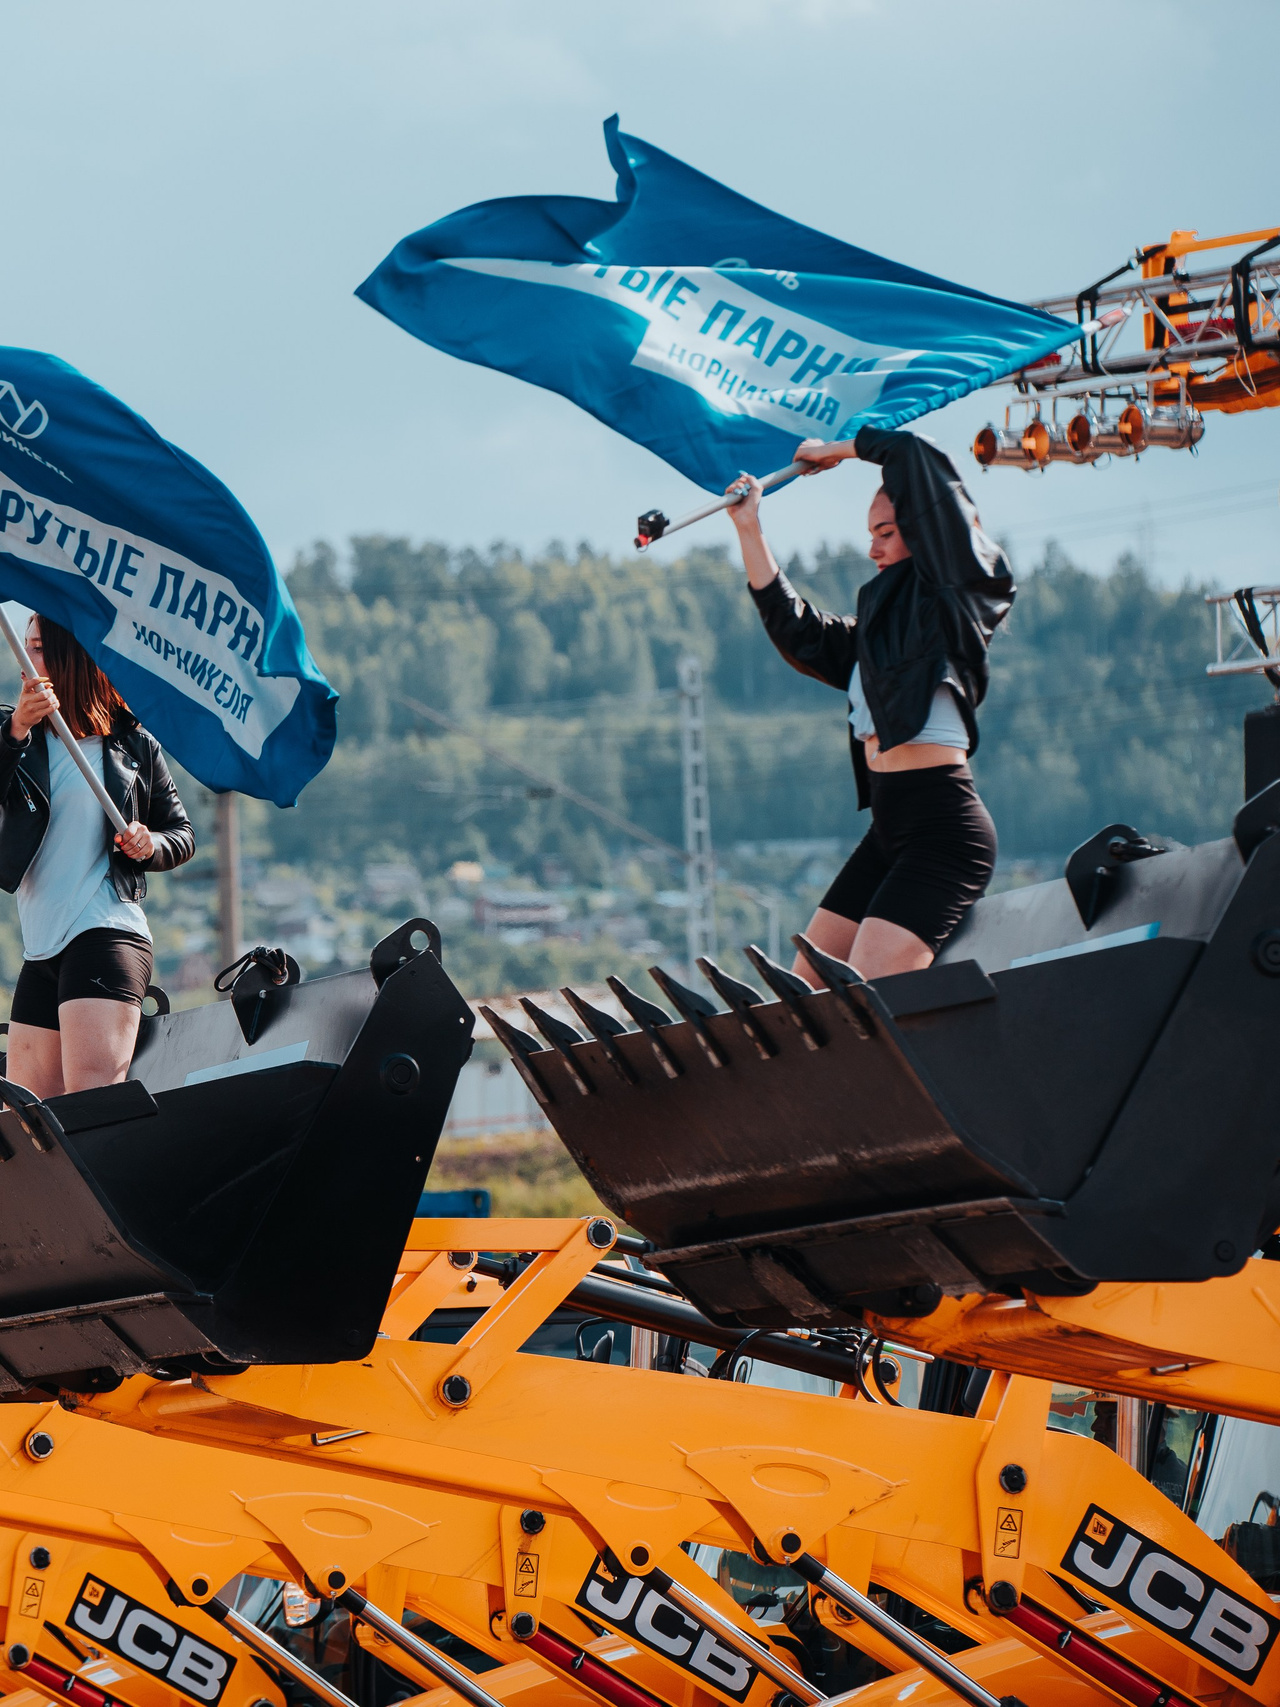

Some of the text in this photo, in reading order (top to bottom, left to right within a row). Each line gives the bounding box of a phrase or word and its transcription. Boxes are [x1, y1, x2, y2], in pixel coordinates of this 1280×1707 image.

[149, 563, 263, 668] ПАРН
[132, 621, 254, 724] НОРНИКЕЛЯ
[74, 1594, 228, 1700] JCB
[586, 1577, 753, 1691] JCB
[1073, 1532, 1270, 1671] JCB
